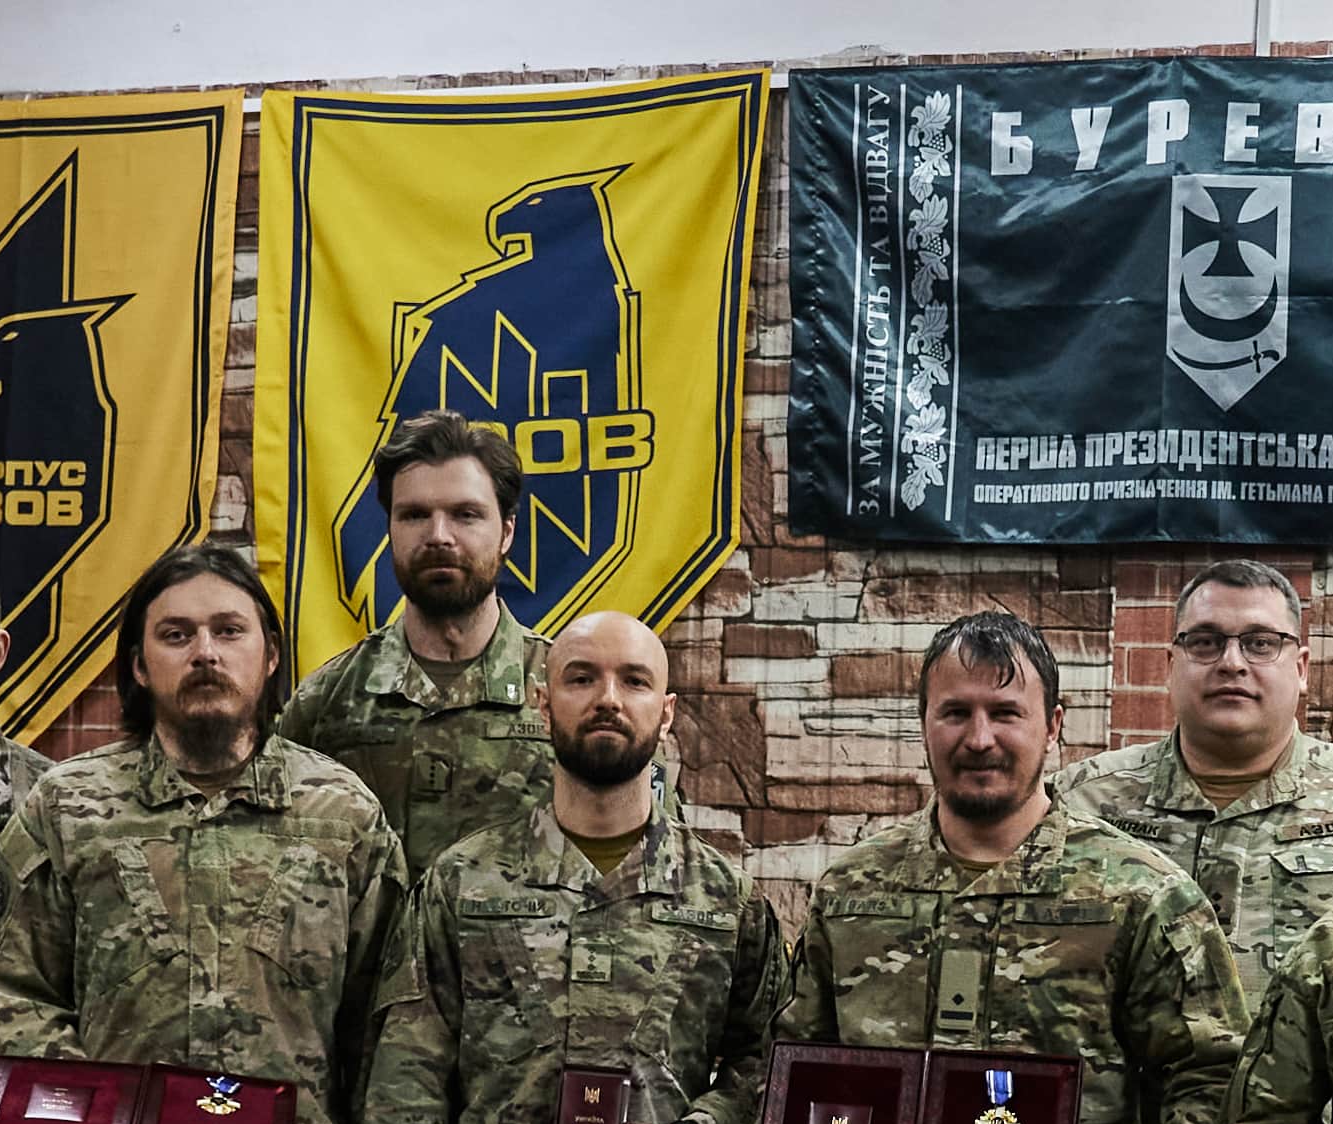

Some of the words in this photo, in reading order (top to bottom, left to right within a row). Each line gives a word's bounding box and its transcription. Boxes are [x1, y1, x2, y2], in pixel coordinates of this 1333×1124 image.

[865, 84, 893, 224] ВІДВАГУ
[868, 236, 892, 277] ТА
[859, 285, 892, 468] МУЖНІСТЬ
[975, 433, 1077, 471] ПЕРША
[858, 476, 882, 516] ЗА
[973, 481, 1091, 504] ОПЕРАТИВНОГО
[1093, 479, 1208, 501] ПРИЗНАЧЕННЯ
[1240, 481, 1324, 504] ГЕТЬМАНА
